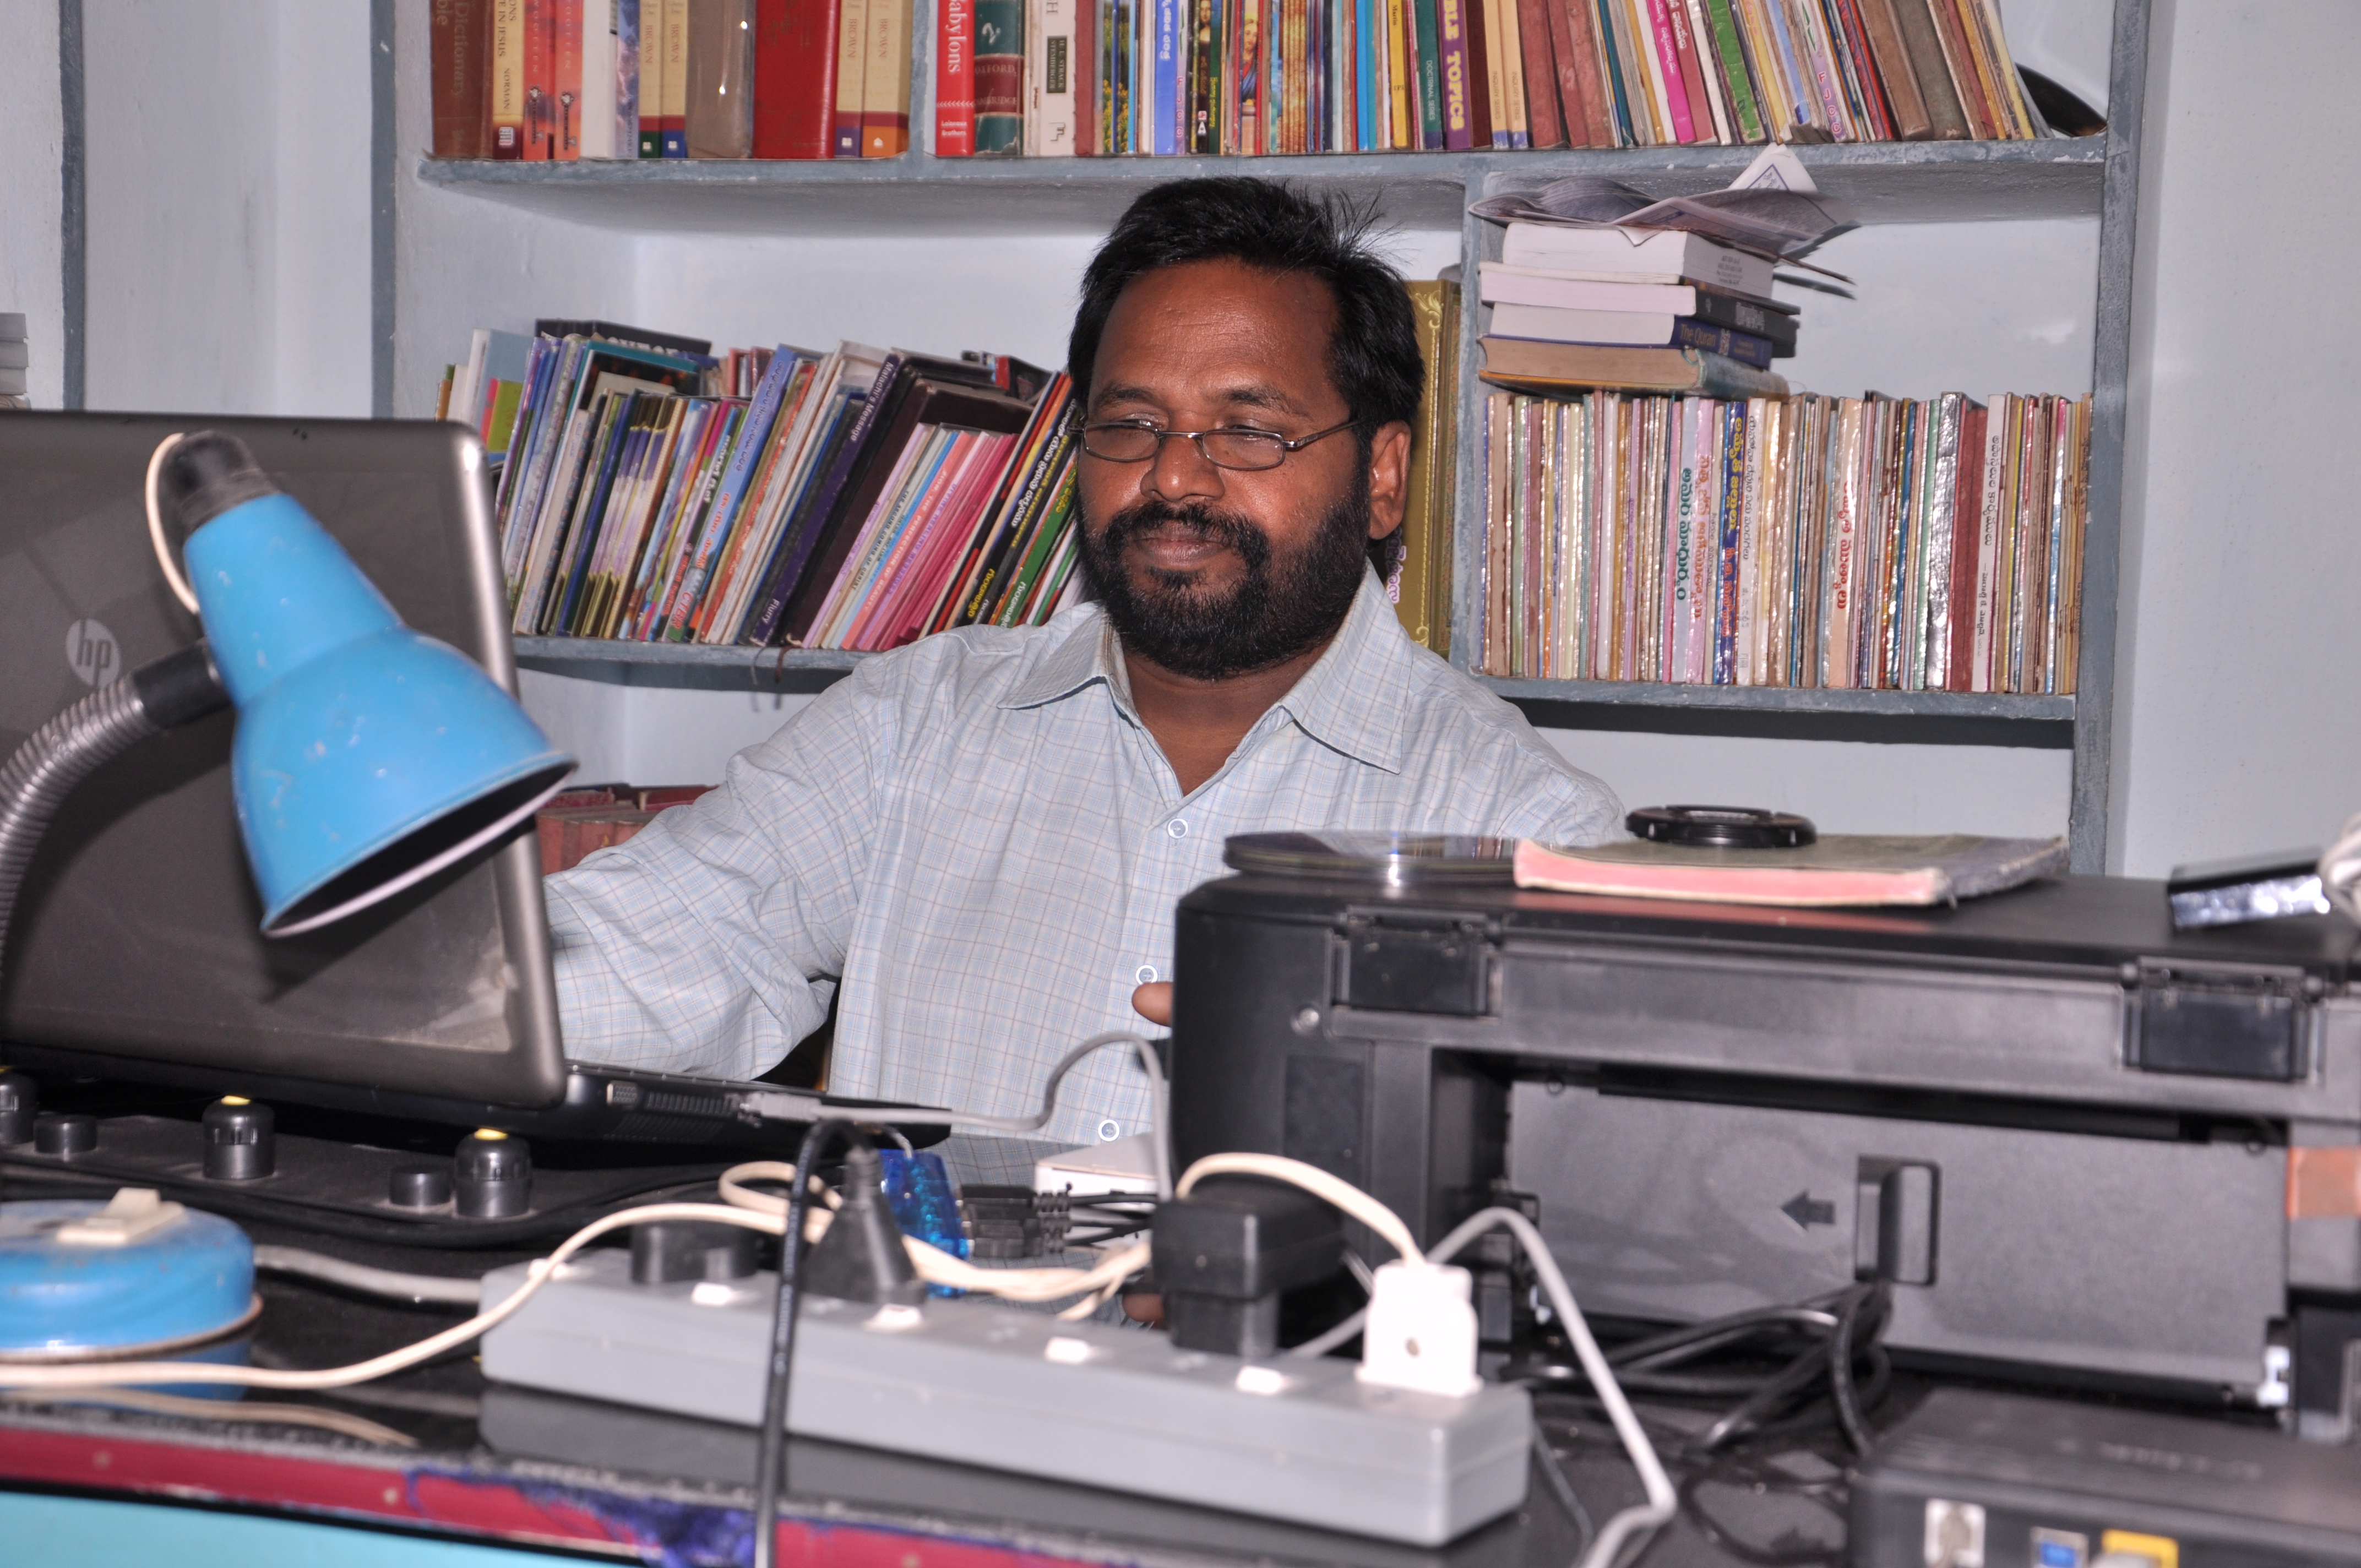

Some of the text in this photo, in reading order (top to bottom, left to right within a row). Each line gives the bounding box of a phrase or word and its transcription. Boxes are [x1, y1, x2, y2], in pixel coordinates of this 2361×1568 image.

[498, 10, 506, 22] IN
[1672, 11, 1688, 49] దానియేలు
[451, 1, 470, 100] Dictionary
[498, 26, 506, 57] JESUS
[644, 24, 654, 64] BROWN
[670, 23, 680, 63] BROWN
[847, 18, 857, 59] BROWN
[878, 18, 888, 58] BROWN
[1426, 60, 1435, 98] DOCTRINAL
[1446, 51, 1466, 130] TOPICS
[1511, 71, 1520, 97] INQUIRY
[1680, 323, 1716, 347] The Quran
[846, 361, 895, 443] Malachi's Message
[1747, 416, 1756, 462] యెహోవా
[1726, 417, 1743, 530] అమృత జల్లులు
[1744, 464, 1754, 492] దేవుని
[1744, 494, 1753, 514] ఏడు
[1983, 491, 1996, 546] కార్యములు
[850, 489, 910, 591] THE SECOND COMING OF CHRIST
[862, 469, 948, 613] ZION, THE PERFECTION OF BEAUTY
[914, 513, 939, 551] HEALING
[1674, 467, 1693, 601] అమర మాధుర్యం
[886, 551, 916, 597] MESSAGES
[1833, 539, 1851, 609] ముత్యాలు
[669, 590, 694, 630] CTBR
[759, 597, 781, 625] Flurry
[73, 618, 117, 689] hp
